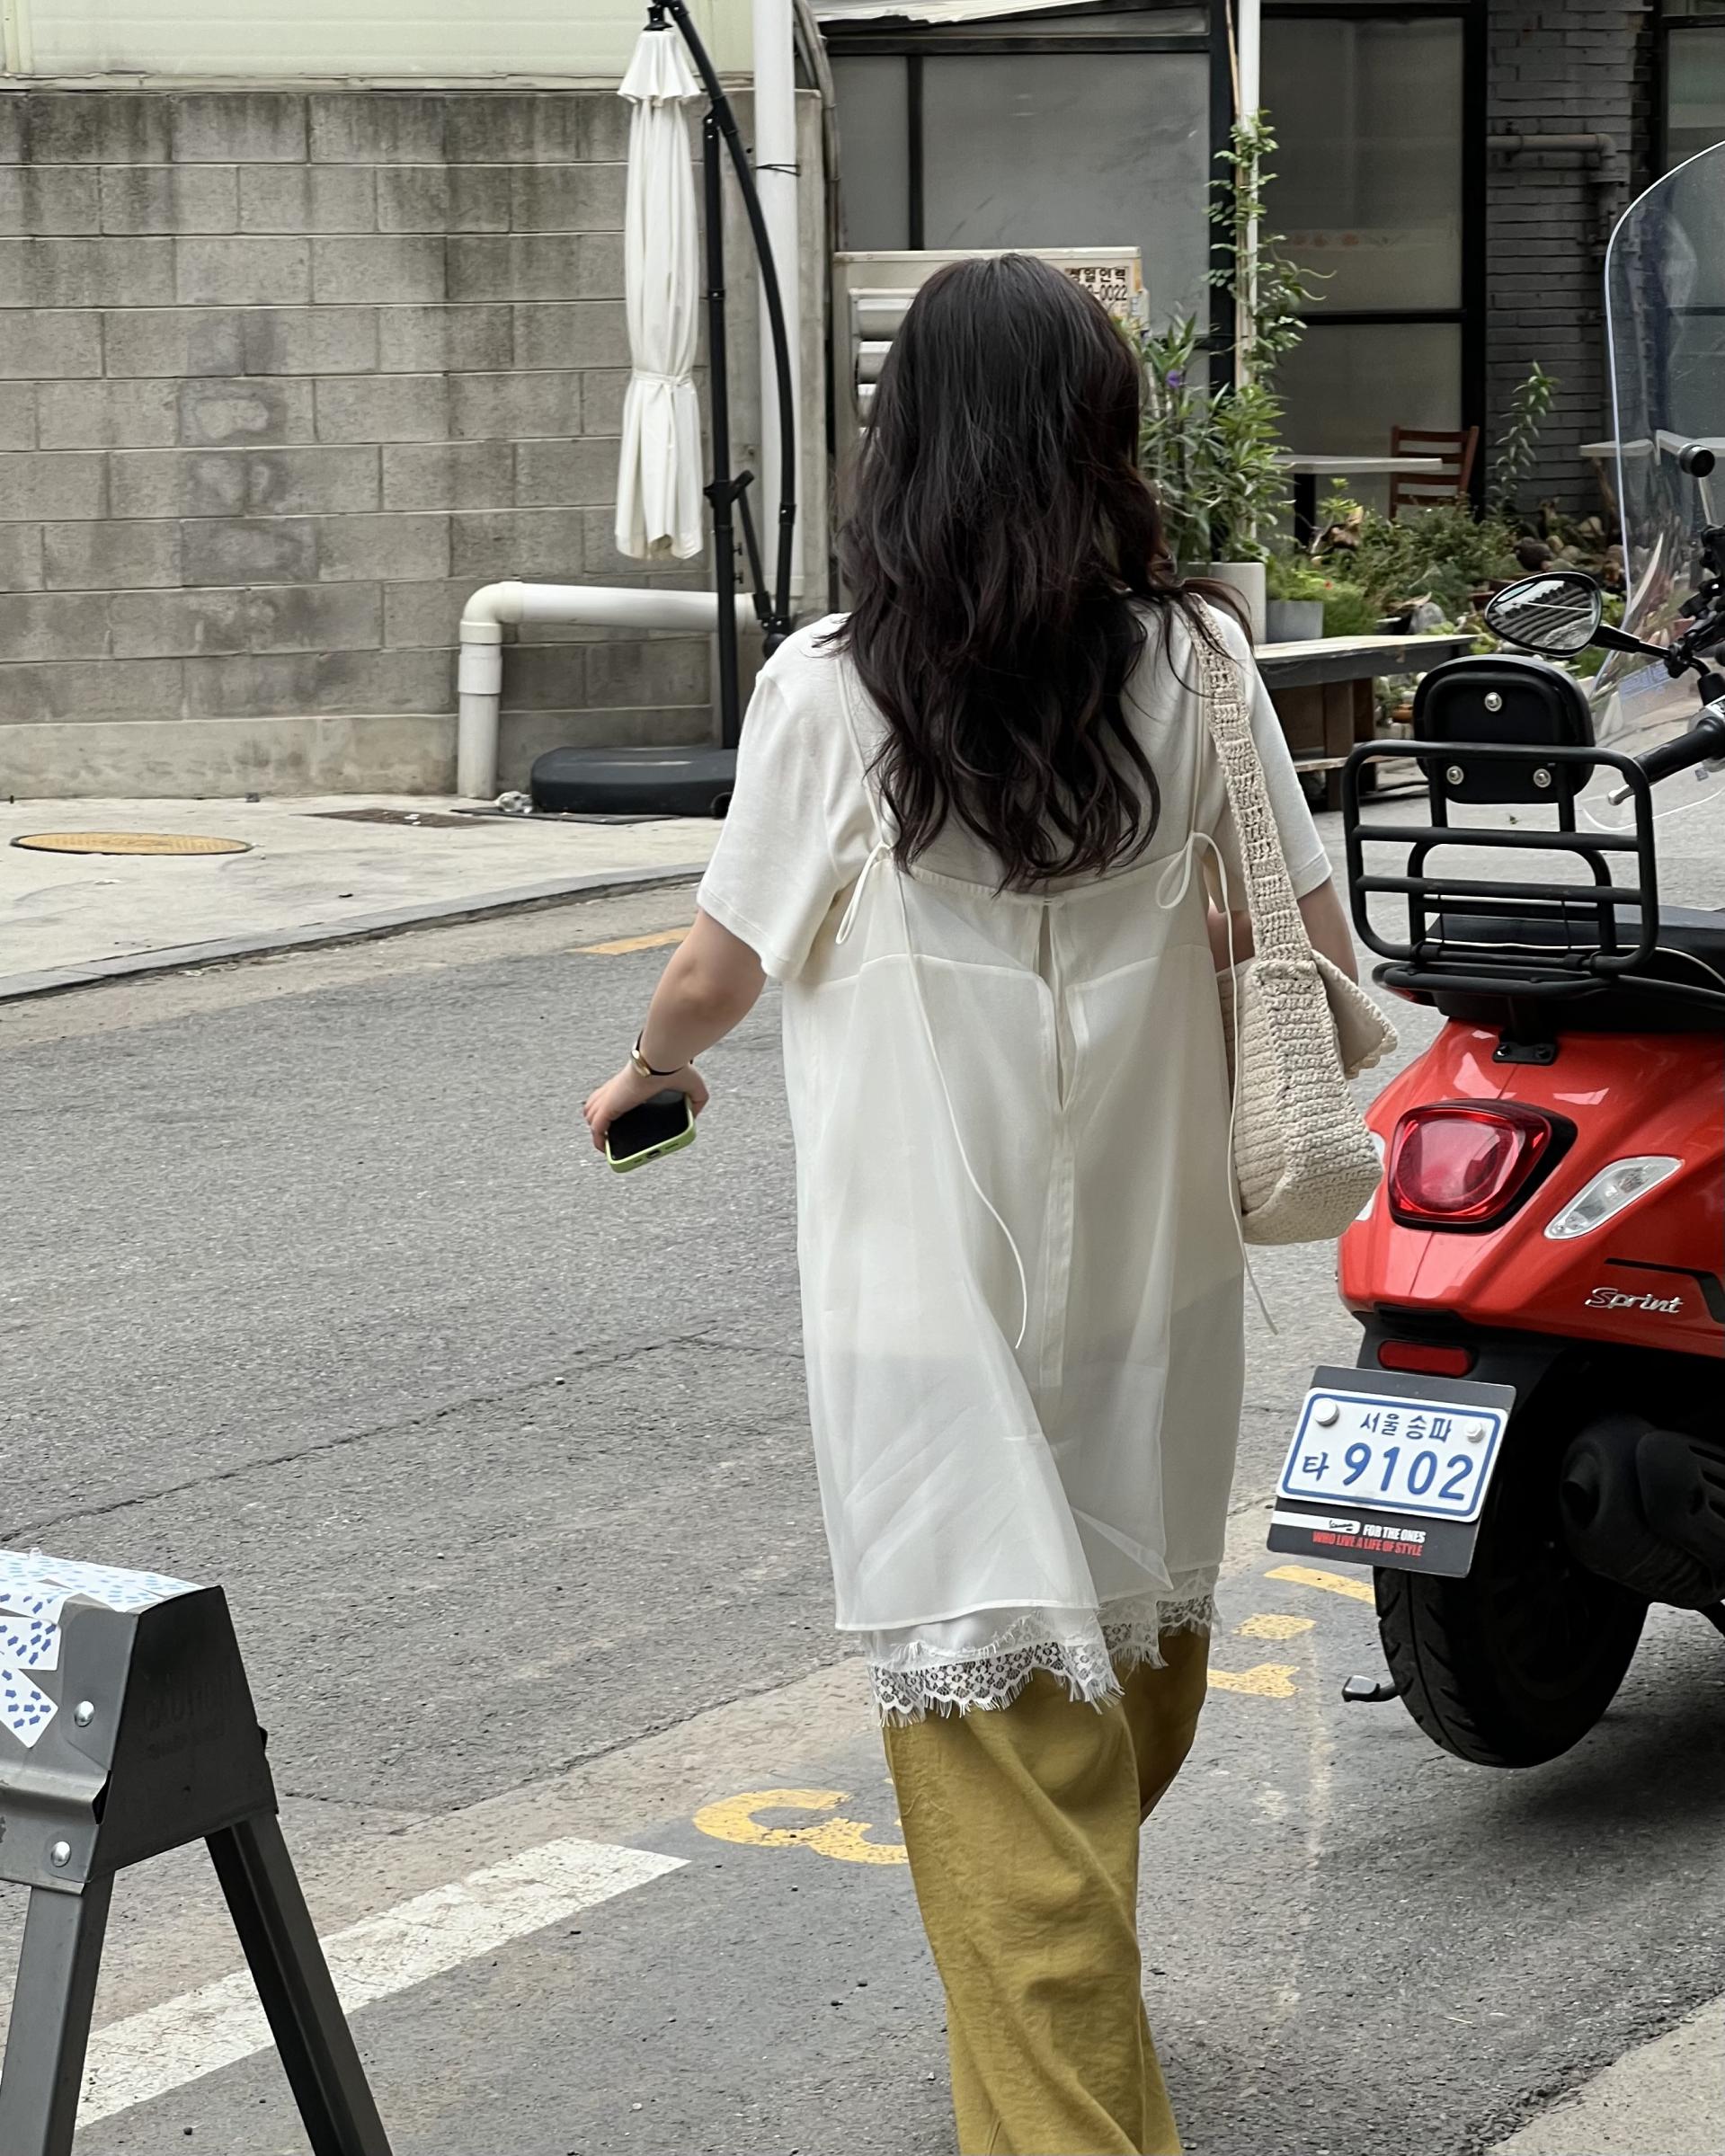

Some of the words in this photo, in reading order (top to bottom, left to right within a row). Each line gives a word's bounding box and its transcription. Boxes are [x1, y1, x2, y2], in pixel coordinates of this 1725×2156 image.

[1585, 1287, 1684, 1314] Sprint
[1360, 1412, 1400, 1436] 서울
[1406, 1415, 1453, 1443] 송파
[1302, 1451, 1329, 1482] 타
[1342, 1442, 1473, 1501] 9102
[1312, 1530, 1336, 1545] WHO
[1336, 1534, 1356, 1548] LIVE
[1363, 1538, 1383, 1551] LIFE
[1383, 1539, 1394, 1552] OF
[1394, 1541, 1423, 1557] STYLE
[1363, 1523, 1382, 1538] FOR
[1383, 1526, 1401, 1540] THE
[1400, 1529, 1427, 1544] ONES
